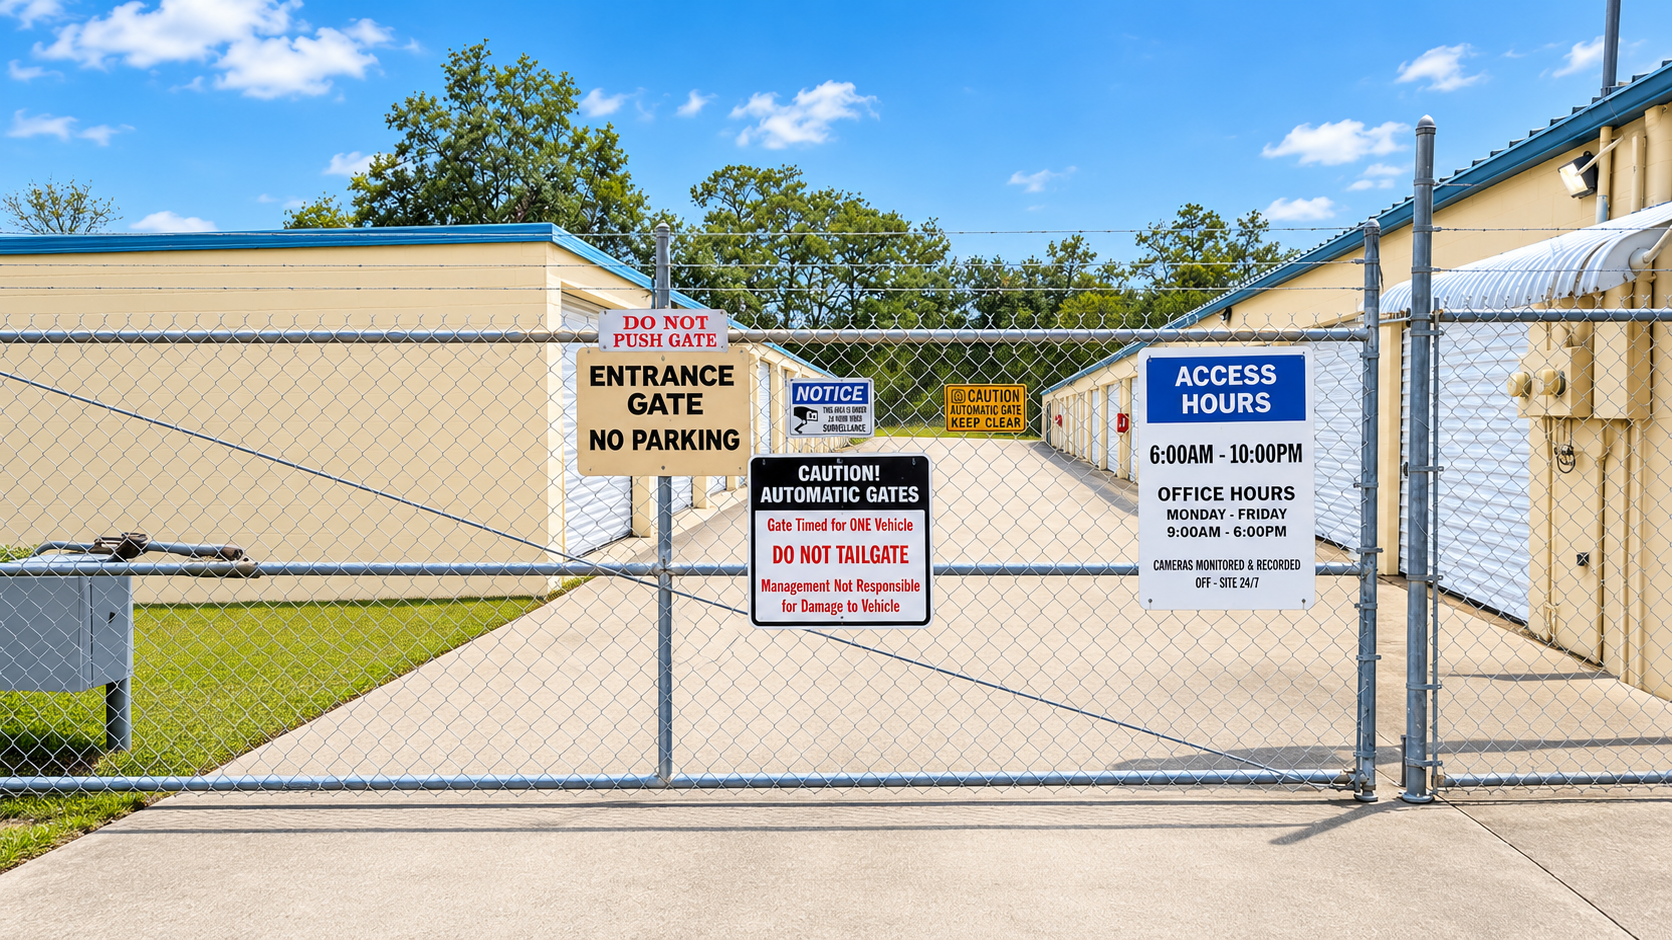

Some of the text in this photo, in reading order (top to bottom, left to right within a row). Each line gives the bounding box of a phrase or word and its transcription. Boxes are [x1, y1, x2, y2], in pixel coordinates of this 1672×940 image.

[623, 316, 709, 330] DO NOT
[613, 333, 717, 348] PUSH GATE
[590, 365, 734, 387] ENTRANCE
[1175, 364, 1277, 387] ACCESS
[796, 386, 864, 402] NOTICE
[968, 389, 1020, 403] CAUTION
[627, 393, 703, 415] GATE
[950, 405, 1022, 415] AUTOMATIC GATE
[1182, 392, 1271, 415] HOURS
[951, 417, 1021, 428] KEEP CLEAR
[589, 429, 740, 451] NO PARKING
[1150, 444, 1213, 464] 6:00AM
[1230, 443, 1303, 464] 10:00PM
[798, 465, 880, 482] CAUTION!
[760, 486, 920, 503] AUTOMATIC GATES
[1157, 485, 1296, 501] OFFICE HOURS
[1167, 508, 1226, 520] MONDAY
[1238, 508, 1287, 520] FRIDAY
[767, 518, 913, 532] Gate Timed for ONE Vehicle
[1167, 526, 1221, 538] 9:00AM
[1233, 526, 1287, 537] 6:00PM
[772, 545, 909, 564] DO NOT TAILGATE
[1153, 559, 1301, 571] CAMERAS MONITORED & RECORDED
[761, 579, 920, 595] Management Not Responsible
[1195, 577, 1211, 588] OFF
[1219, 577, 1238, 588] SITE
[1239, 577, 1260, 589] 24/7
[782, 599, 900, 615] for Damage to Vehicle
